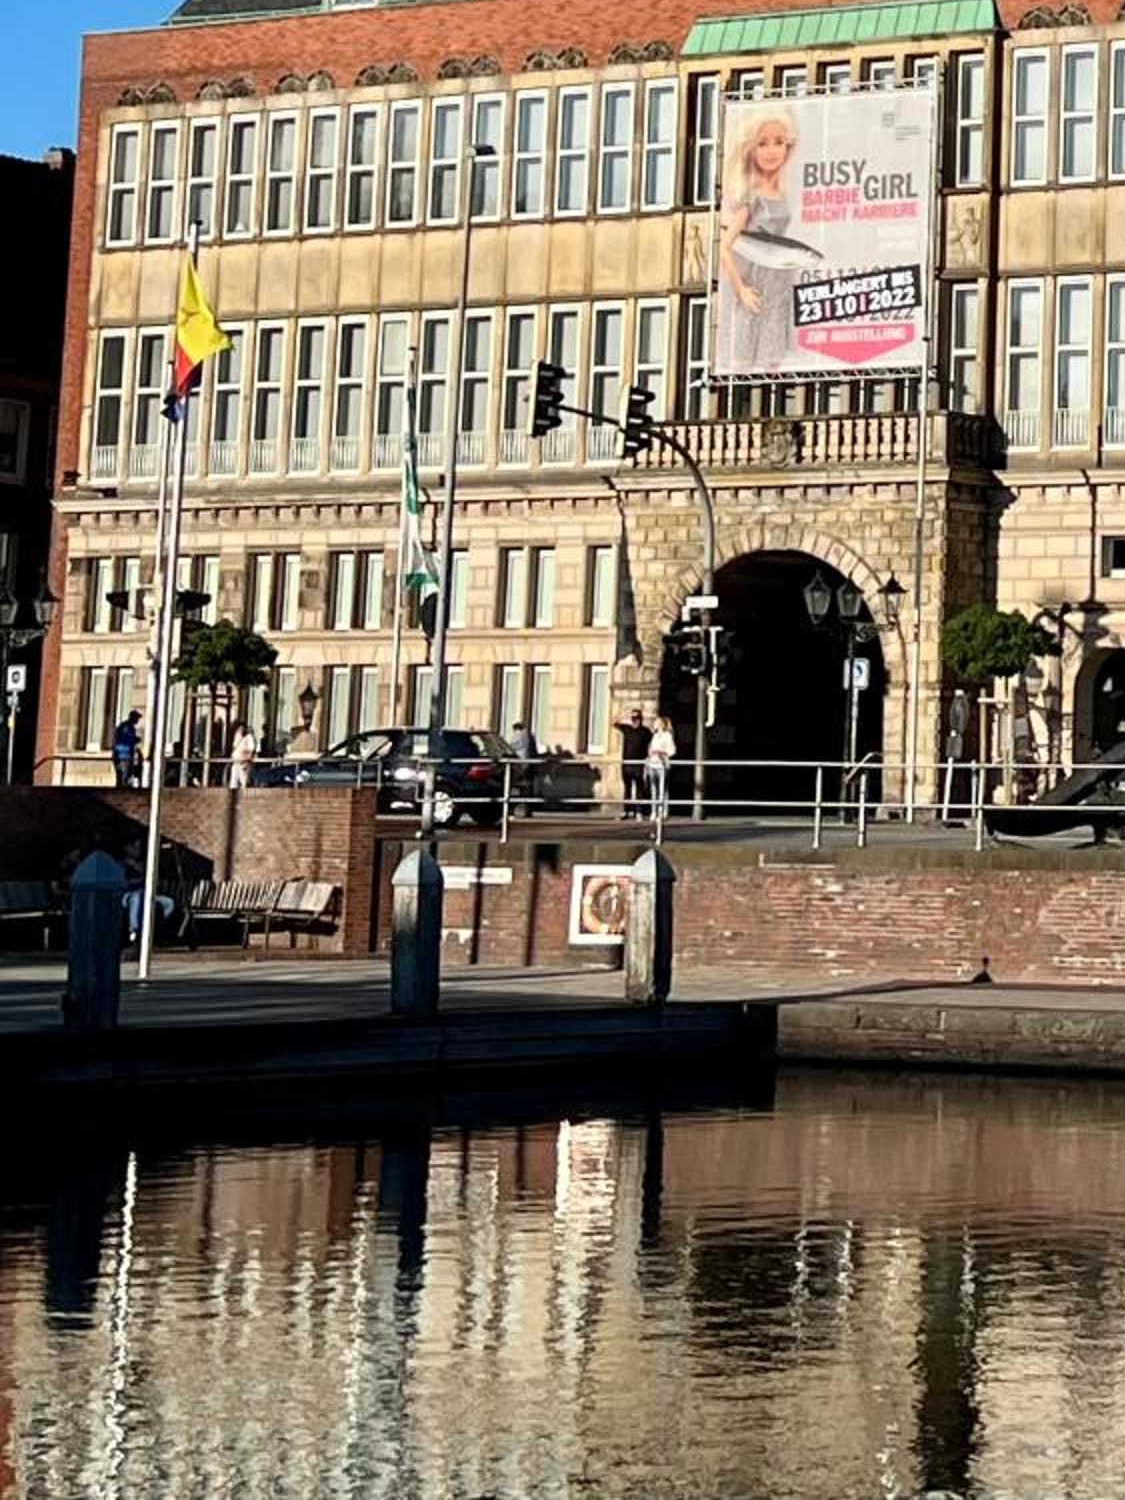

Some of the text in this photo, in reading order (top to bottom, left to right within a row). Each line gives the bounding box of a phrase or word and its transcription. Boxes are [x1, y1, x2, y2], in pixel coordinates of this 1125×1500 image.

[803, 160, 866, 187] BUSY
[802, 188, 860, 205] BARBIE
[864, 174, 918, 200] GIRL
